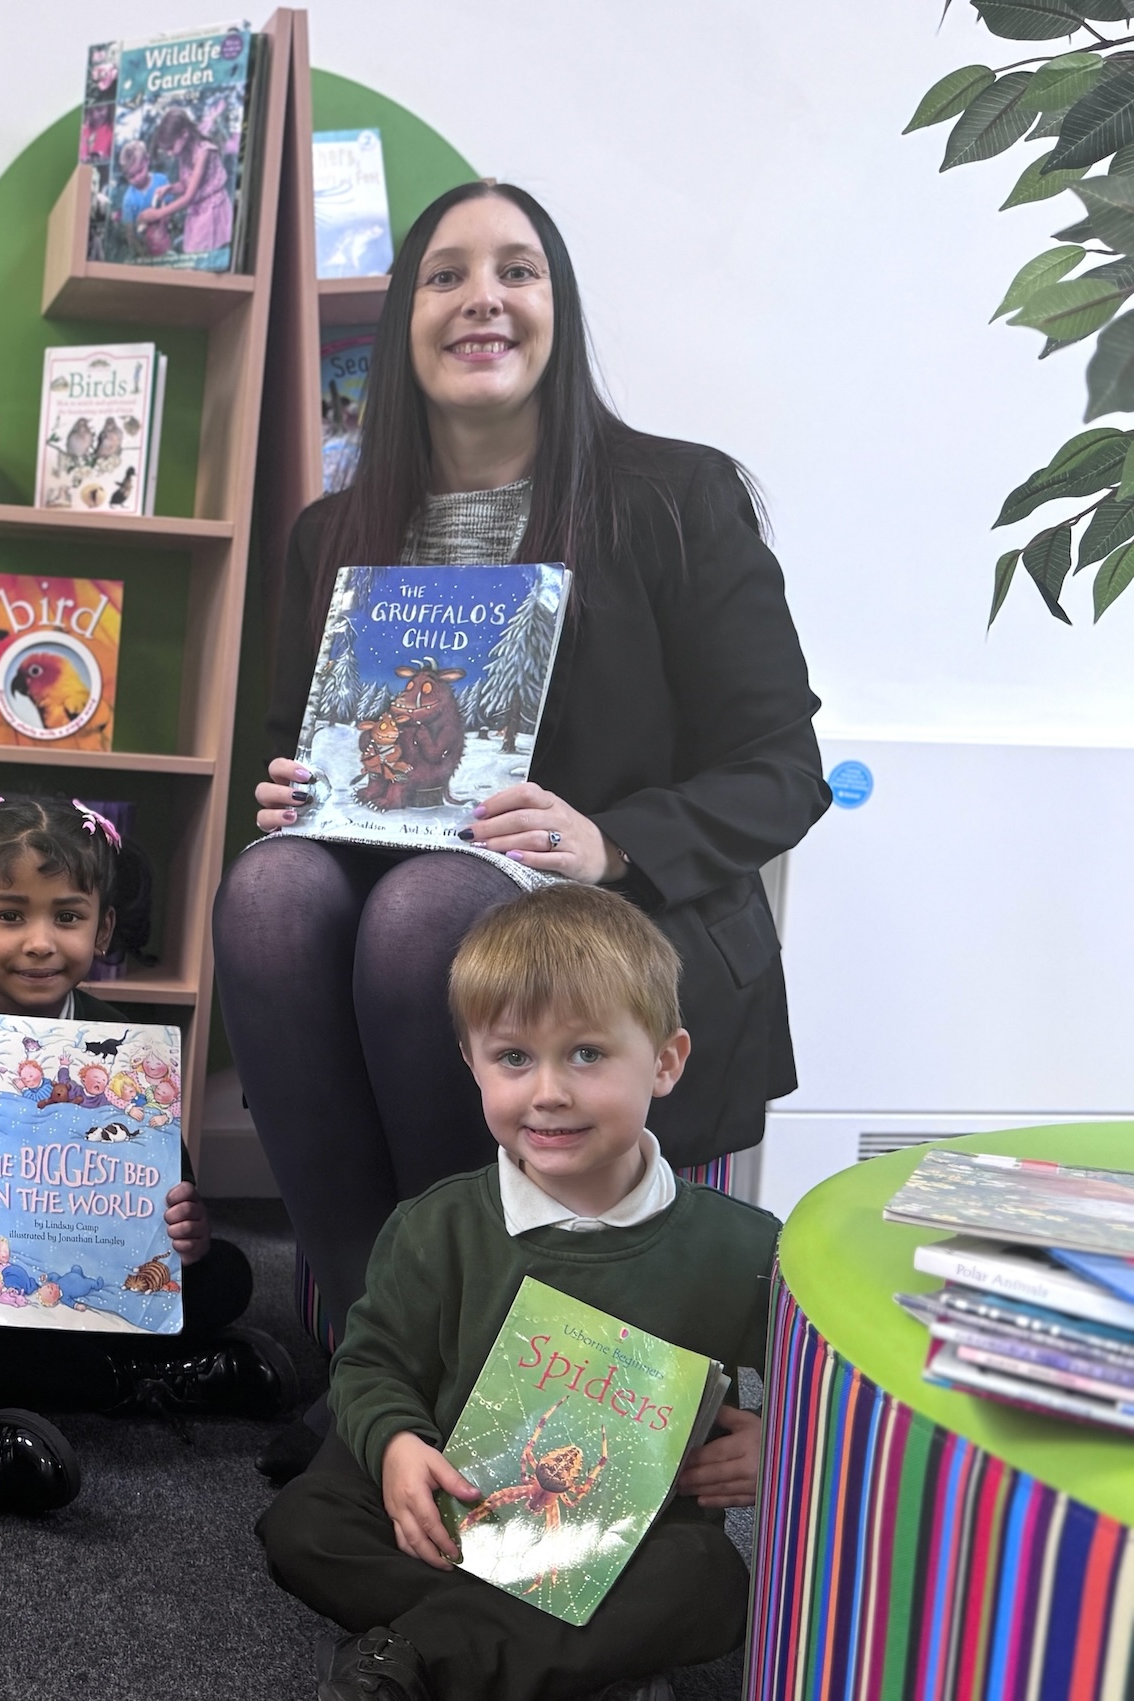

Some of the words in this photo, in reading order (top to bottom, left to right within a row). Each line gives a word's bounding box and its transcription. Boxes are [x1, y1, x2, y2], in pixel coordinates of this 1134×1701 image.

[146, 40, 221, 69] Wildlife
[147, 66, 214, 91] Garden
[68, 371, 127, 398] Birds
[511, 514, 527, 549] STAFF
[400, 584, 426, 598] THE
[371, 601, 507, 625] GRUFFALO'S
[402, 629, 468, 651] CHILD
[19, 1143, 120, 1187] BIGGEST
[124, 1162, 161, 1188] BED
[17, 1187, 64, 1215] THE
[69, 1192, 154, 1220] WORLD
[9, 1231, 46, 1241] illustrated
[47, 1232, 57, 1243] by
[58, 1233, 93, 1244] Jonathan
[95, 1235, 125, 1246] Langley
[34, 1219, 44, 1231] by
[45, 1219, 74, 1233] Lindsay
[76, 1222, 99, 1234] Camp
[956, 1262, 989, 1286] Polar
[991, 1267, 1049, 1299] Animals
[564, 1324, 610, 1355] Usborne
[612, 1347, 665, 1380] Beginners
[518, 1335, 674, 1432] Spiders
